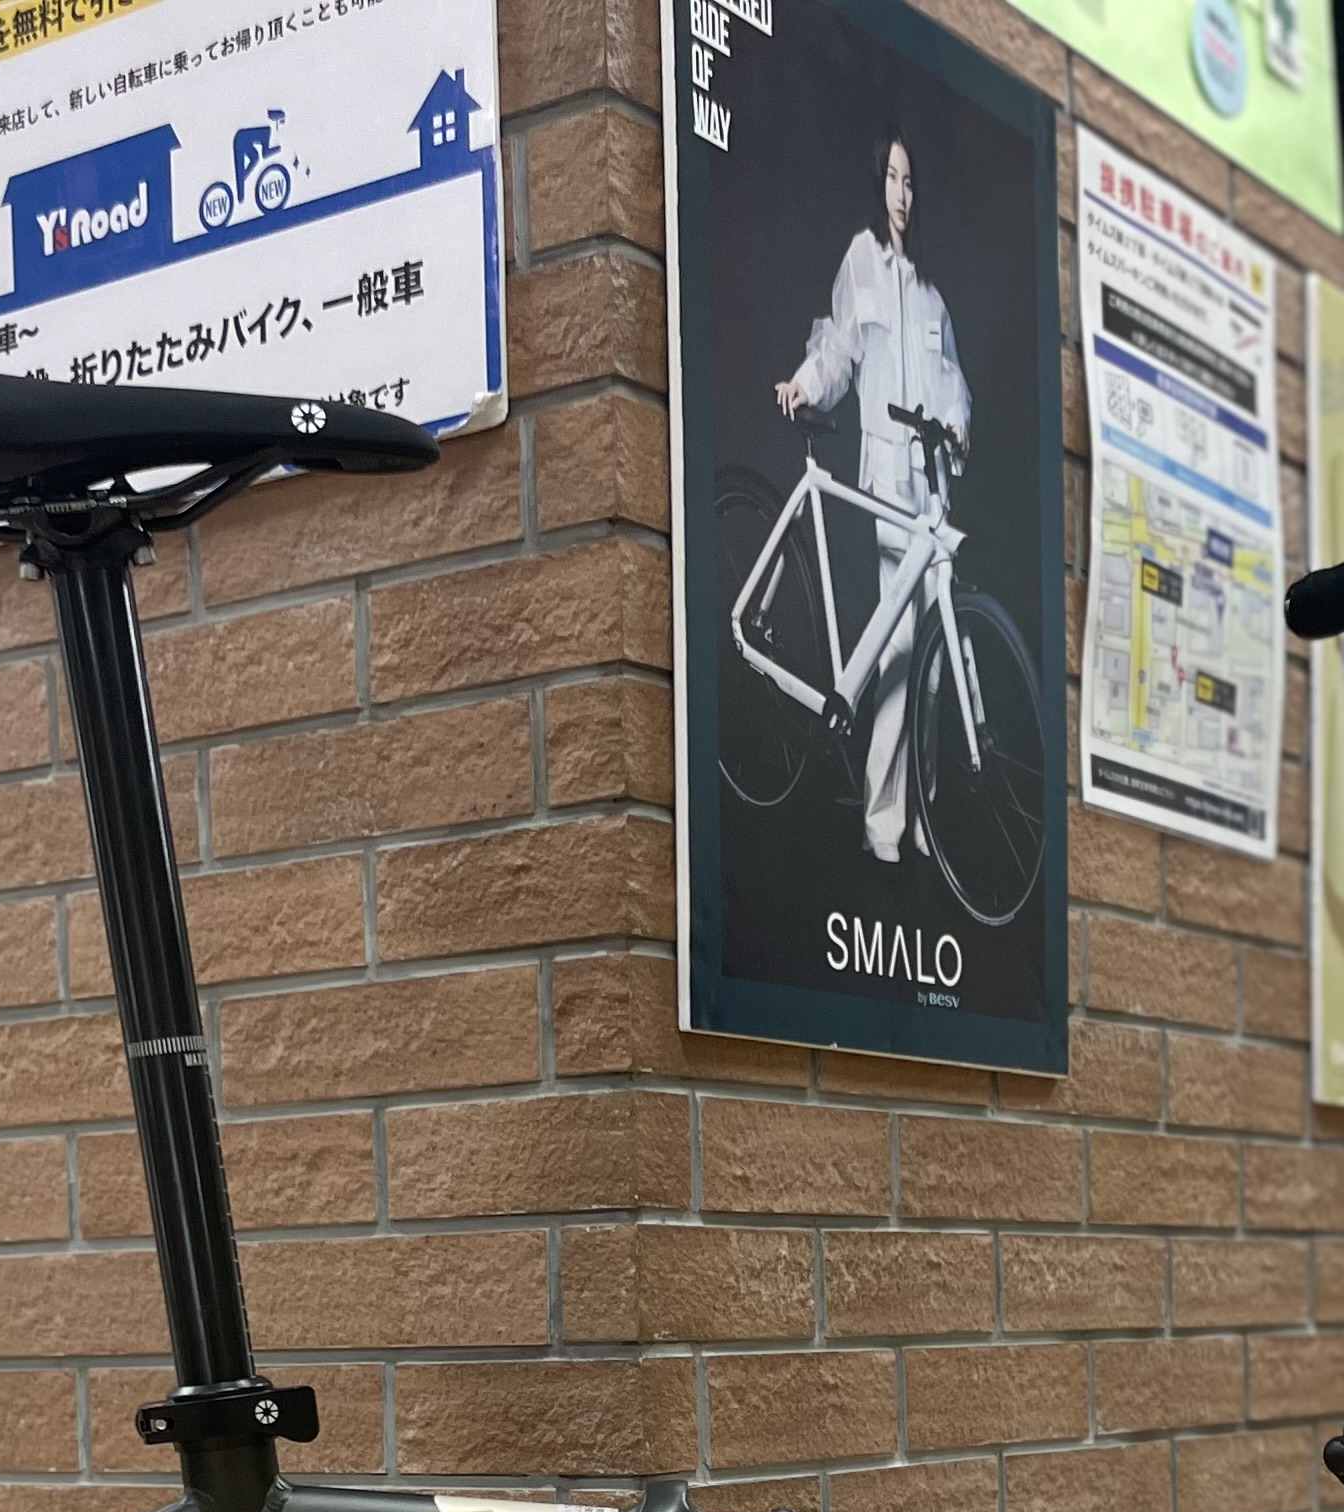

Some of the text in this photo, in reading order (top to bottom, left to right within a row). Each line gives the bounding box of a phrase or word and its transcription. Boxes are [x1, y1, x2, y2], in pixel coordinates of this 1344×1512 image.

[690, 0, 731, 57] RIDE
[691, 41, 714, 91] OF
[692, 87, 731, 152] WAY
[205, 179, 286, 219] NEW NEW
[24, 260, 425, 386] 折りたたみバイク、一般車
[327, 377, 410, 409] 象です
[825, 911, 963, 988] SMALO
